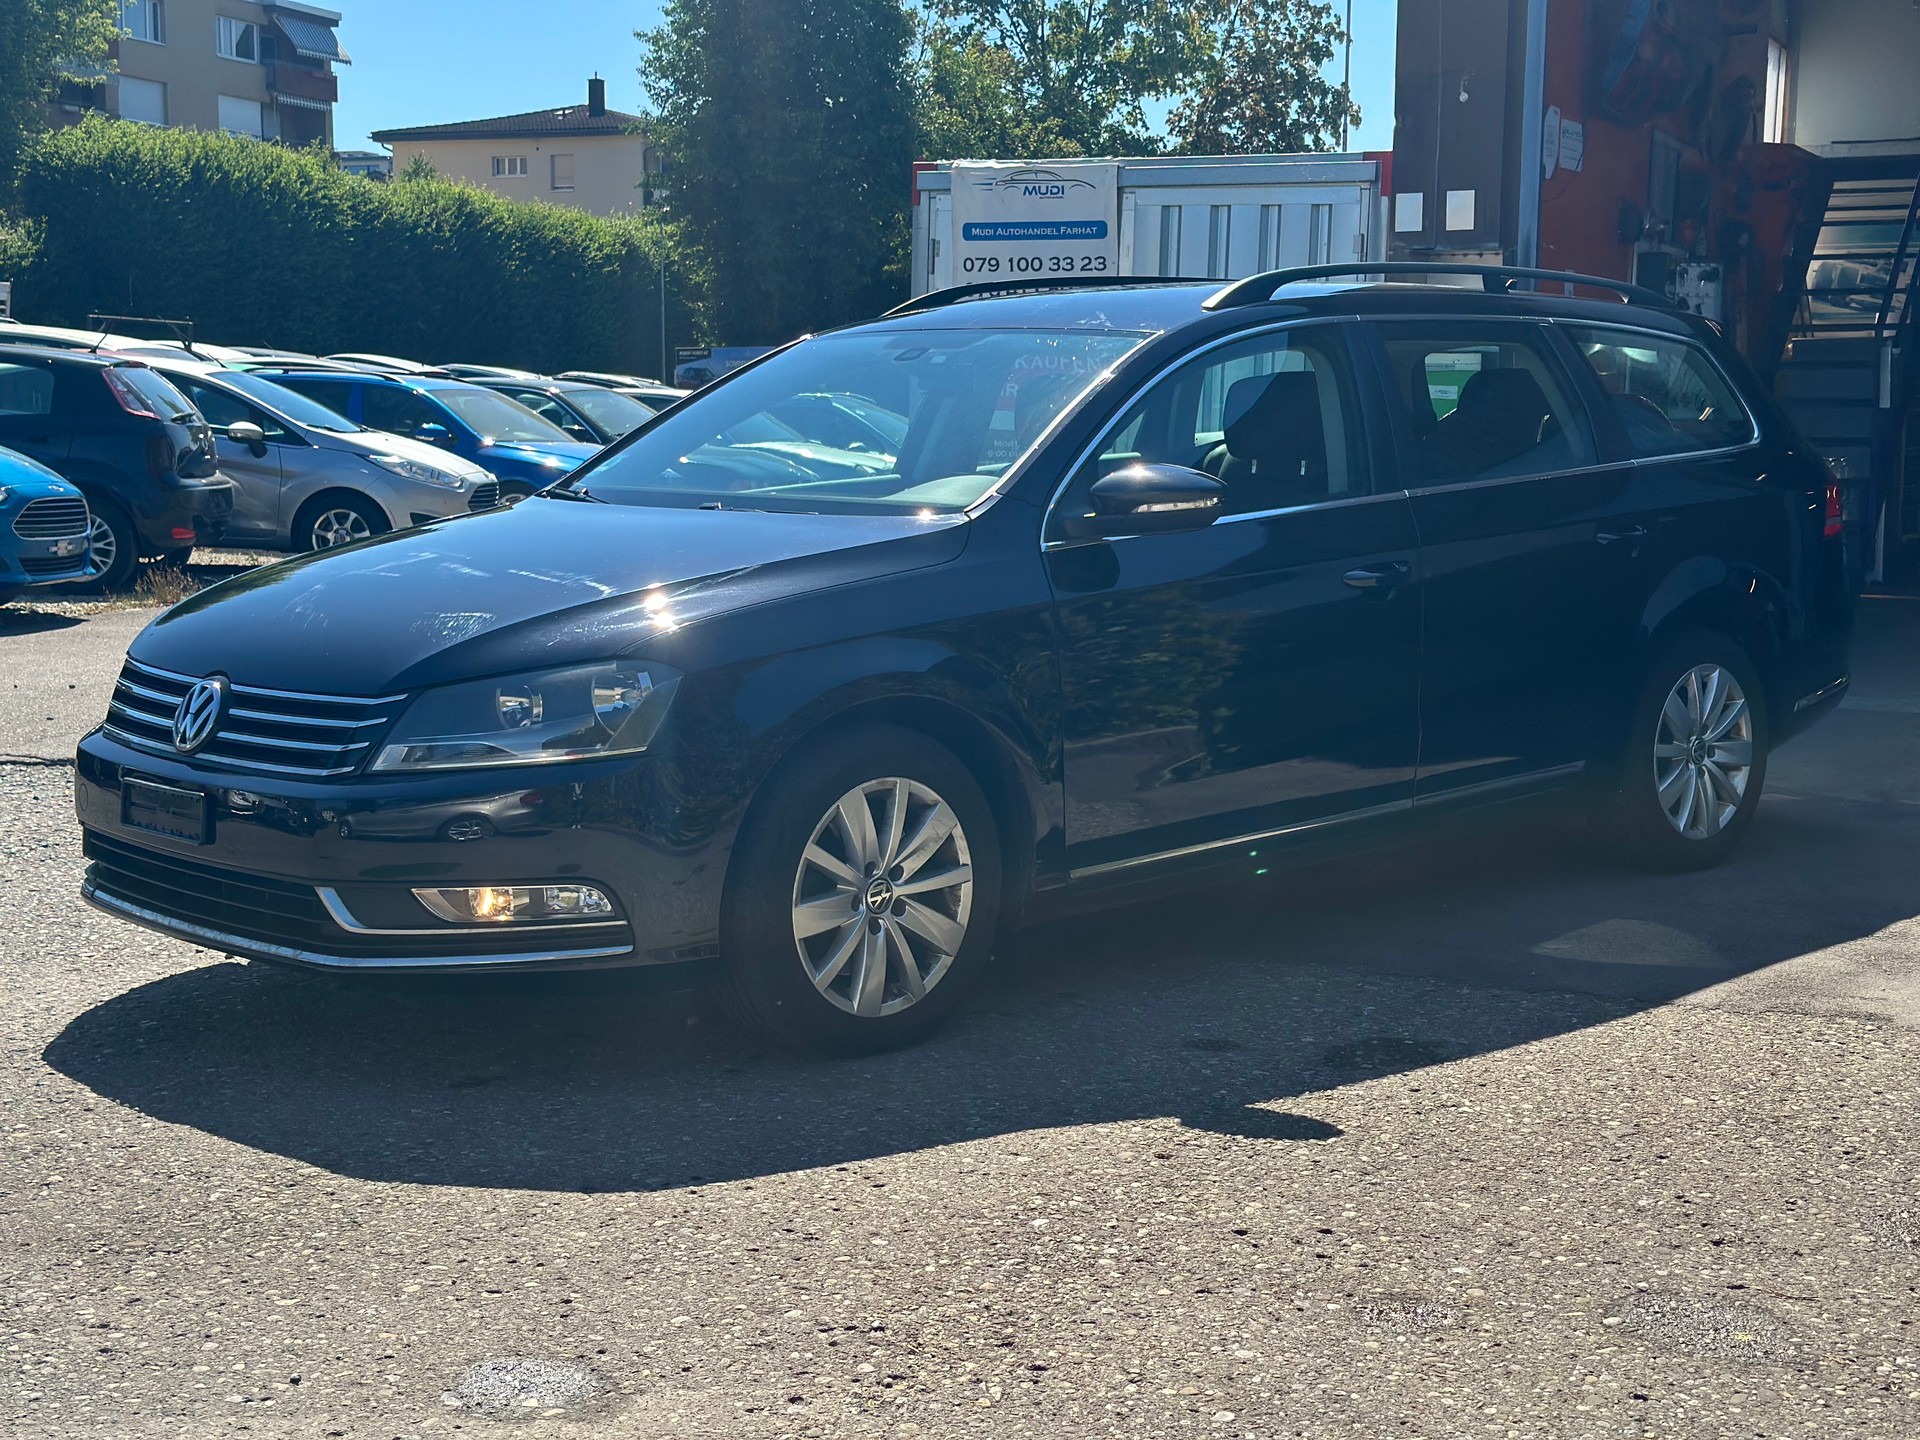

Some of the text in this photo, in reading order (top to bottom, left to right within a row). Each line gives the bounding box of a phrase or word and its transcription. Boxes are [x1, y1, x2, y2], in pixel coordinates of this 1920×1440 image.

[1022, 185, 1065, 196] MUDI
[971, 226, 1098, 236] MUDI AUTOHANDEL FARHAT
[962, 255, 1108, 273] 079 100 33 23
